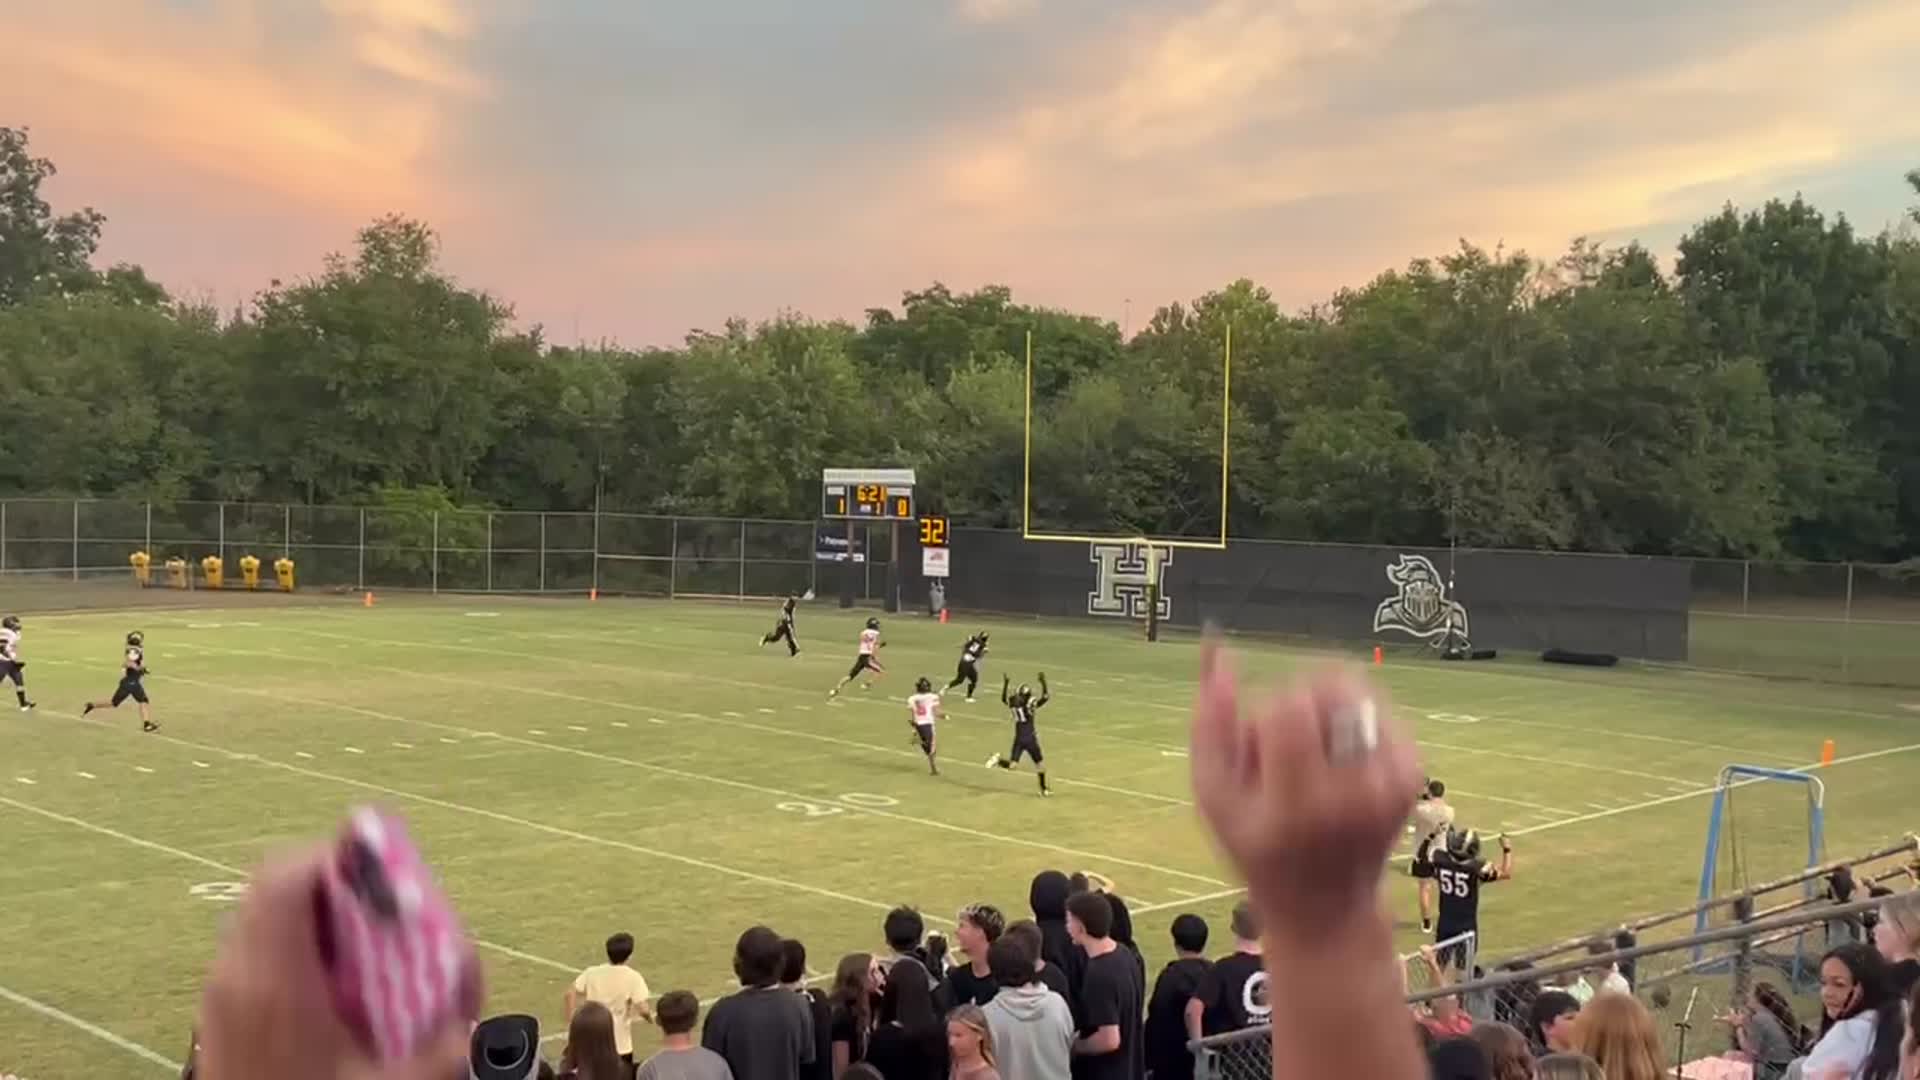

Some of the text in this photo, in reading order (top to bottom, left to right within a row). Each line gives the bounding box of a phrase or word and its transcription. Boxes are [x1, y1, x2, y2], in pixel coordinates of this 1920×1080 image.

[898, 498, 908, 516] 0
[919, 518, 945, 544] 32
[1088, 541, 1173, 619] H
[1440, 869, 1469, 898] 55
